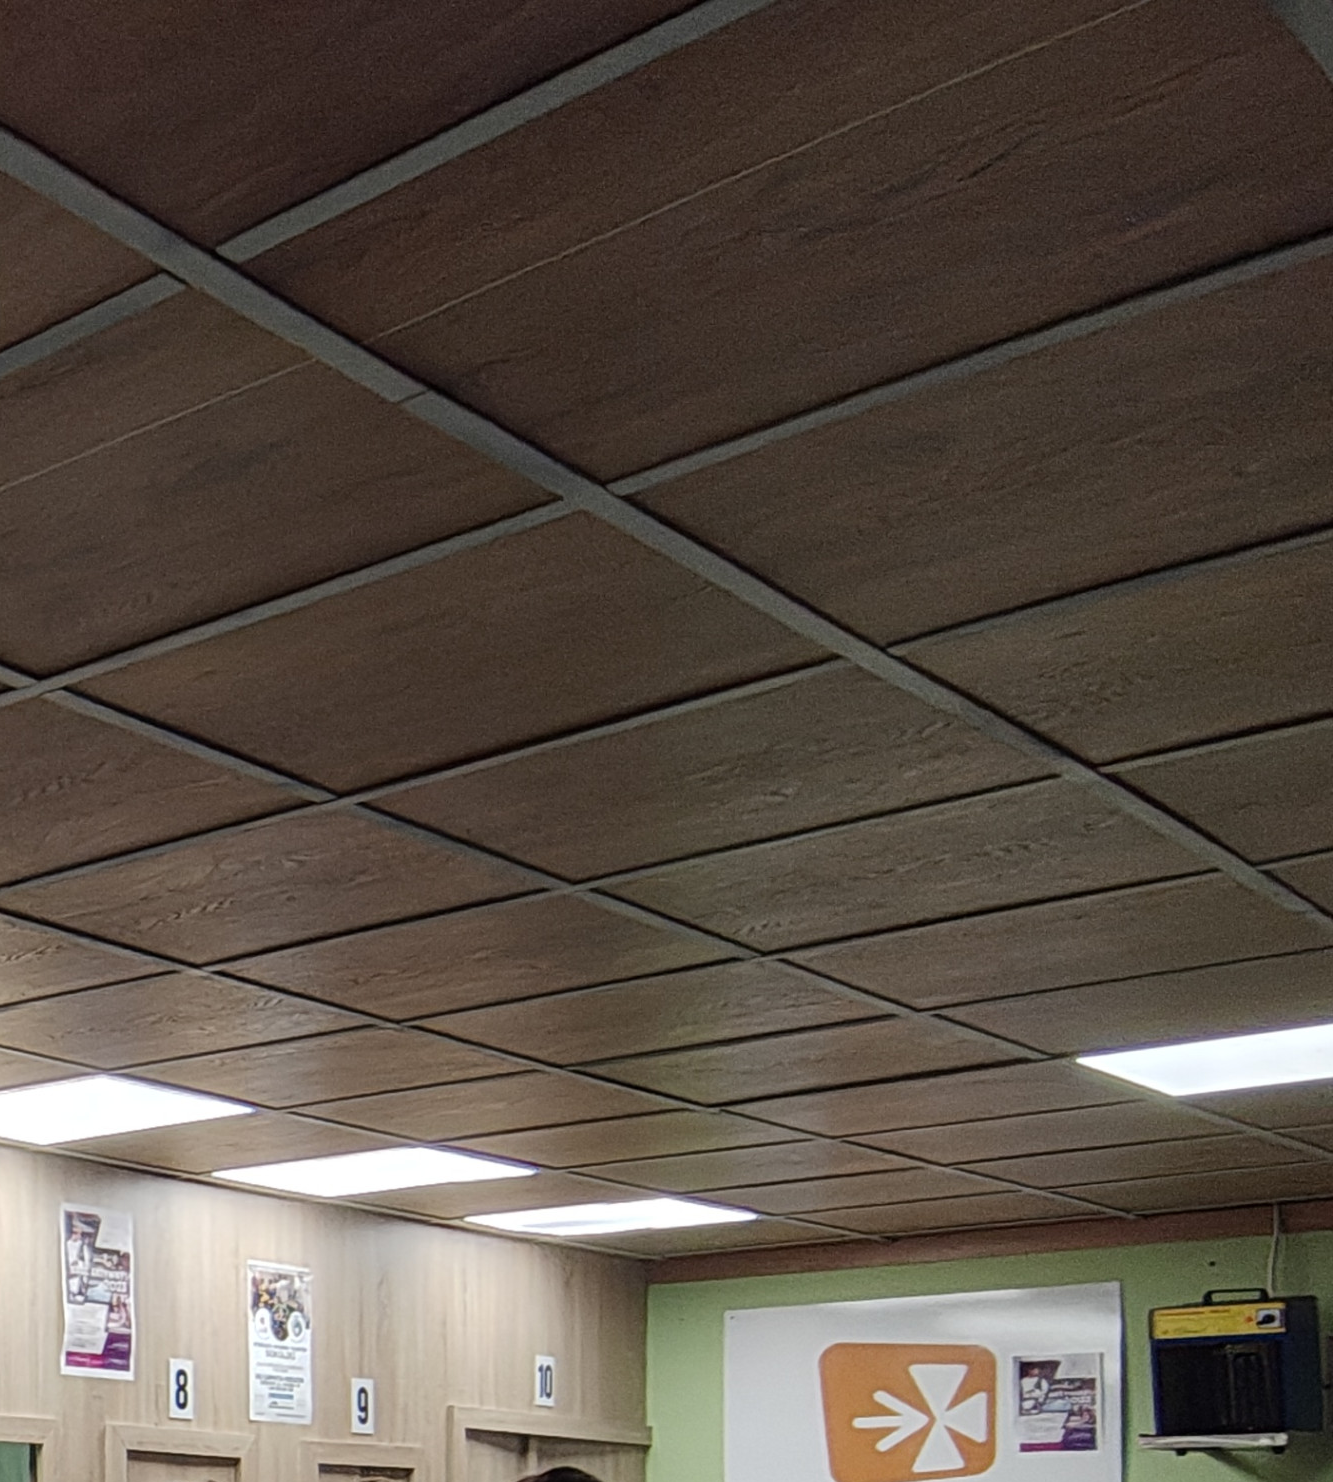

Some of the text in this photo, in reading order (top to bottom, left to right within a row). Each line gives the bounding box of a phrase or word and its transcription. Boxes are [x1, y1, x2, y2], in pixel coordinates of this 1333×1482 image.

[175, 1368, 189, 1410] 8
[537, 1364, 554, 1400] 10
[357, 1386, 369, 1425] 9
